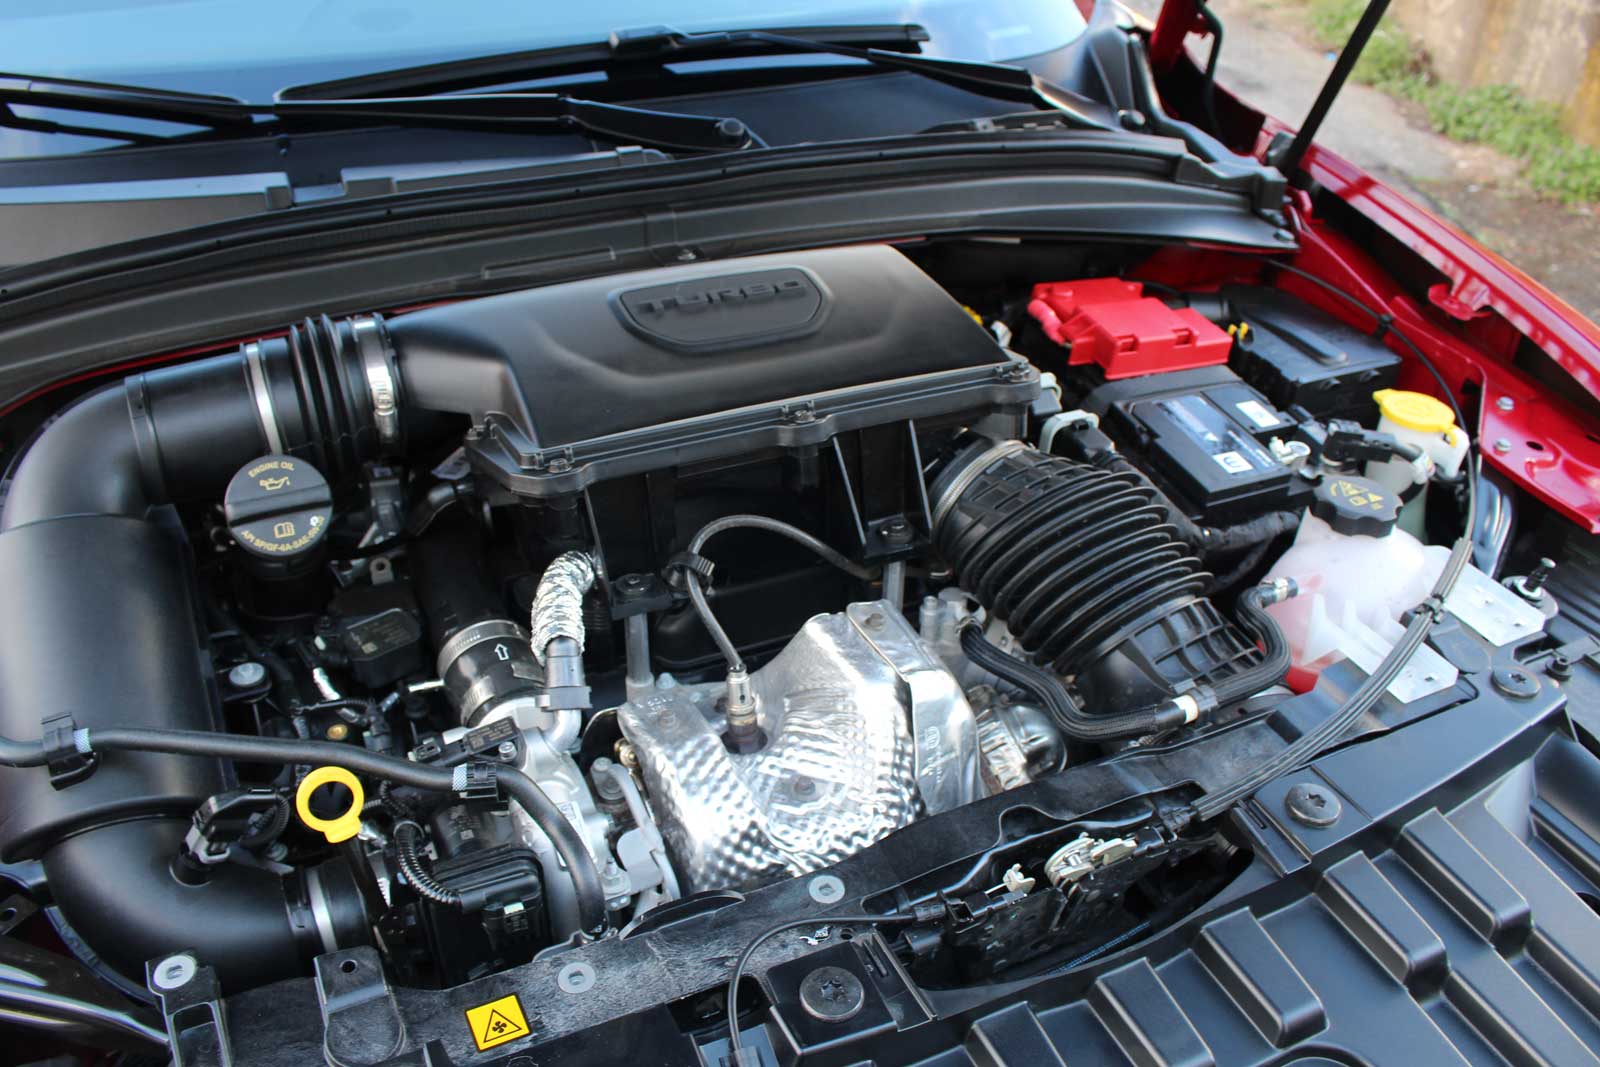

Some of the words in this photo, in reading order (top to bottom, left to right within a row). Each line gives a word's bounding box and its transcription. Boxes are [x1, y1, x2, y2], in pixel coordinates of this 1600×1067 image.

[637, 280, 807, 319] TURBO
[248, 461, 279, 478] ENGINE
[280, 461, 295, 471] OIL
[241, 530, 255, 543] API
